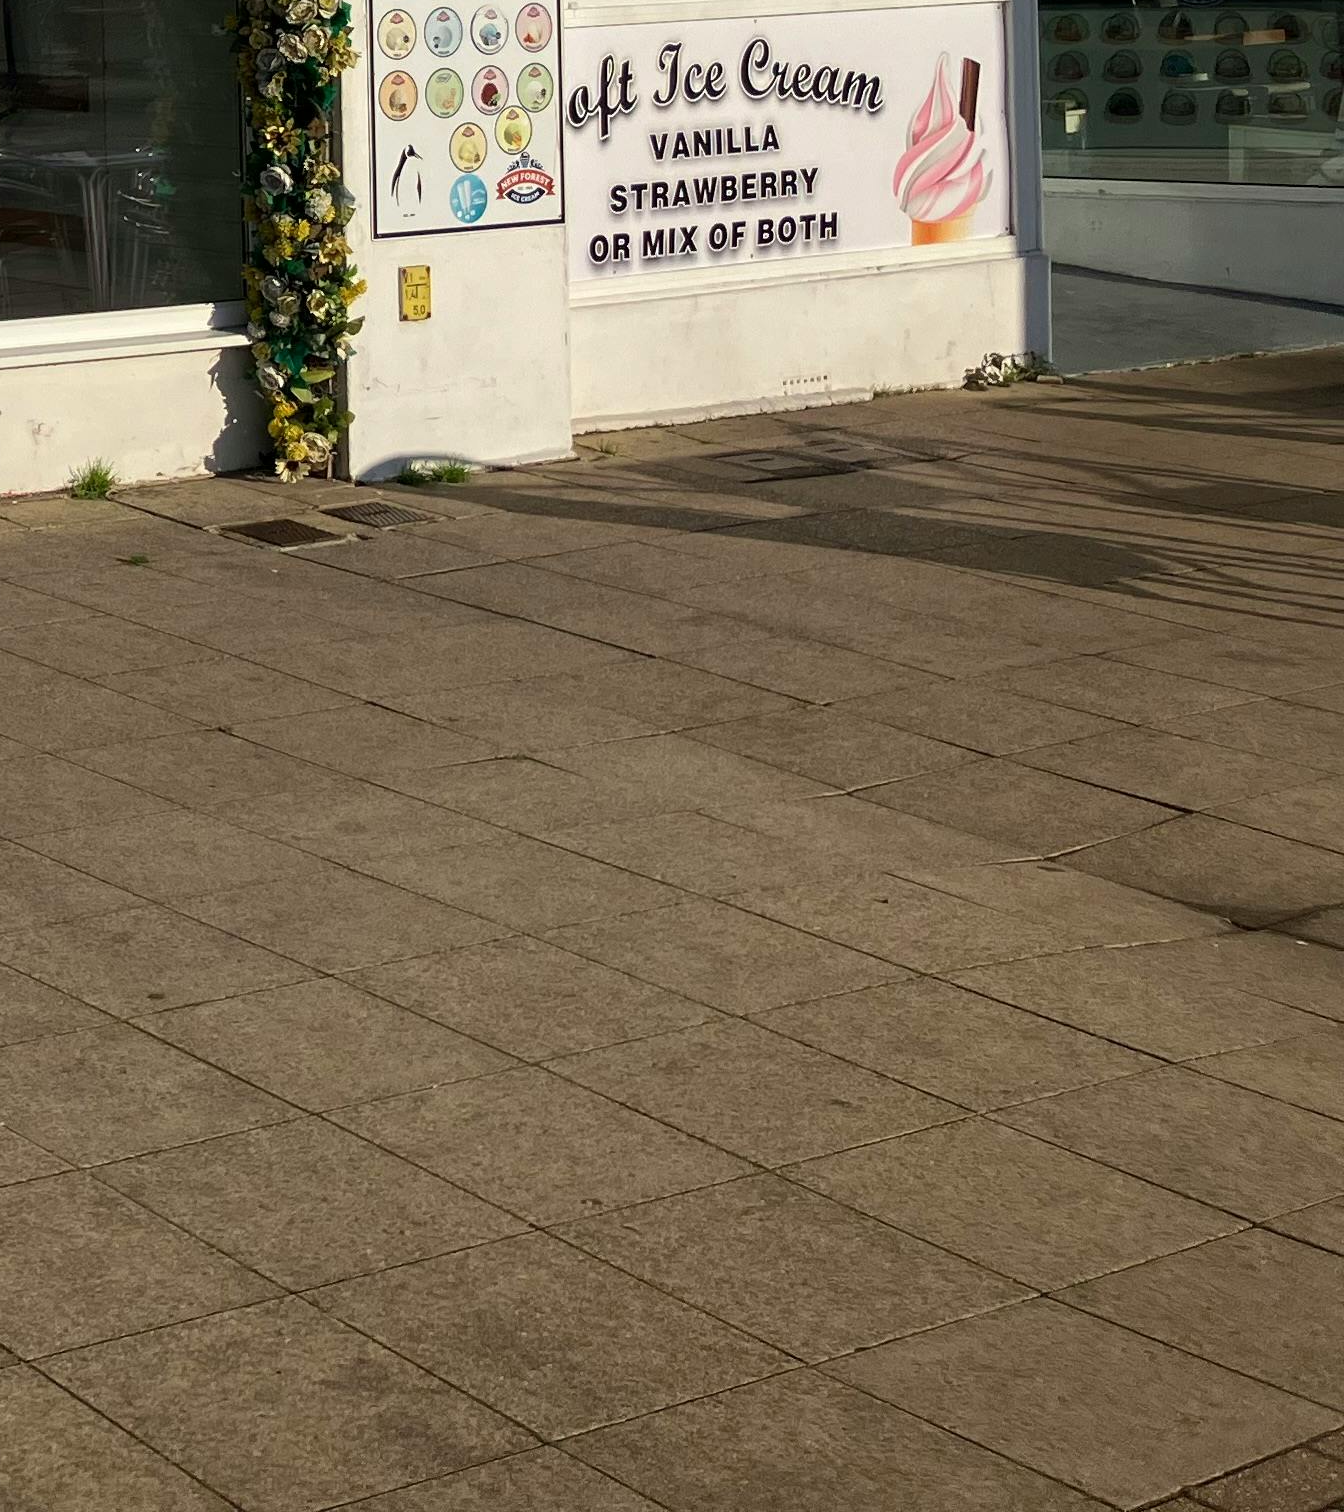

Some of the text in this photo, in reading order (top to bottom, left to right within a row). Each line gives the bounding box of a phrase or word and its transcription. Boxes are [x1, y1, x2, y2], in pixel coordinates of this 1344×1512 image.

[567, 38, 884, 140] oft Ice Cream
[649, 124, 780, 160] VANILLA
[501, 172, 551, 190] NEW FOREST
[609, 167, 819, 213] STRAWBERRY
[589, 211, 839, 264] OR MIX OF BOTH
